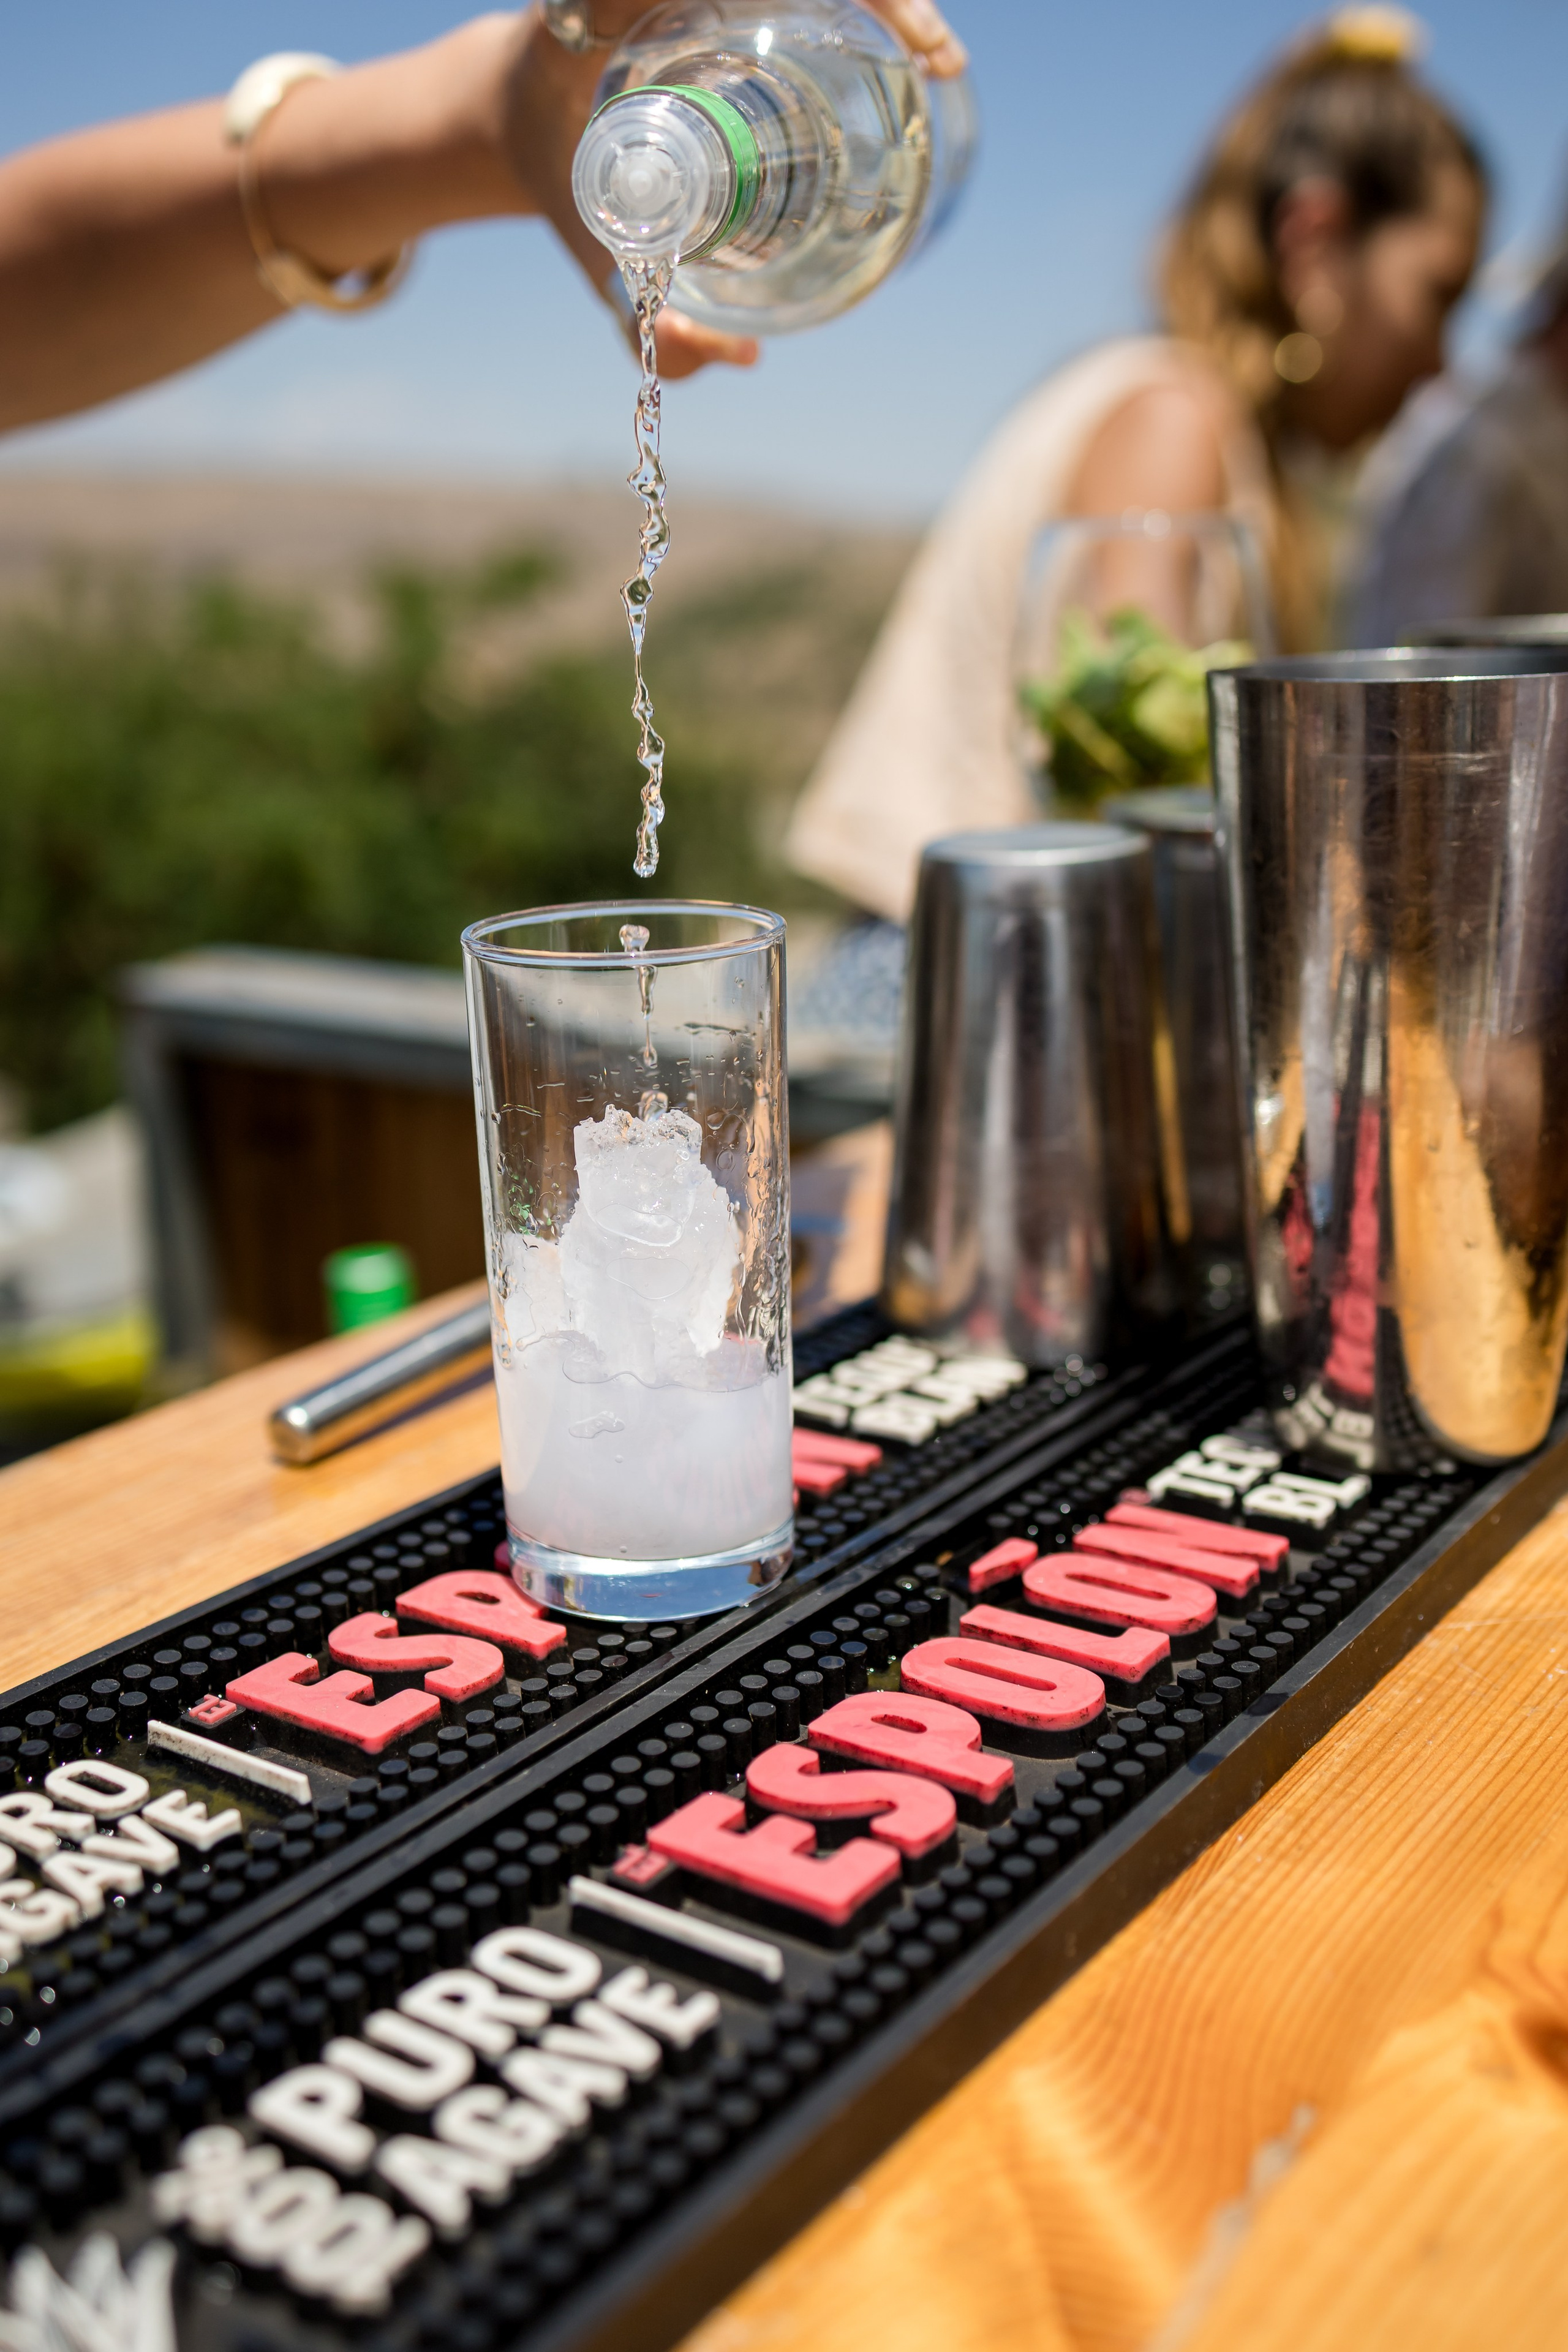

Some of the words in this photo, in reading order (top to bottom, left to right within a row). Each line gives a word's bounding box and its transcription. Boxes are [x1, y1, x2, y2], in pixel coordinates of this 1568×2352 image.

[0, 1789, 243, 1966] GAVE
[249, 1926, 602, 2176] PURO
[375, 1966, 722, 2242] AGAVE
